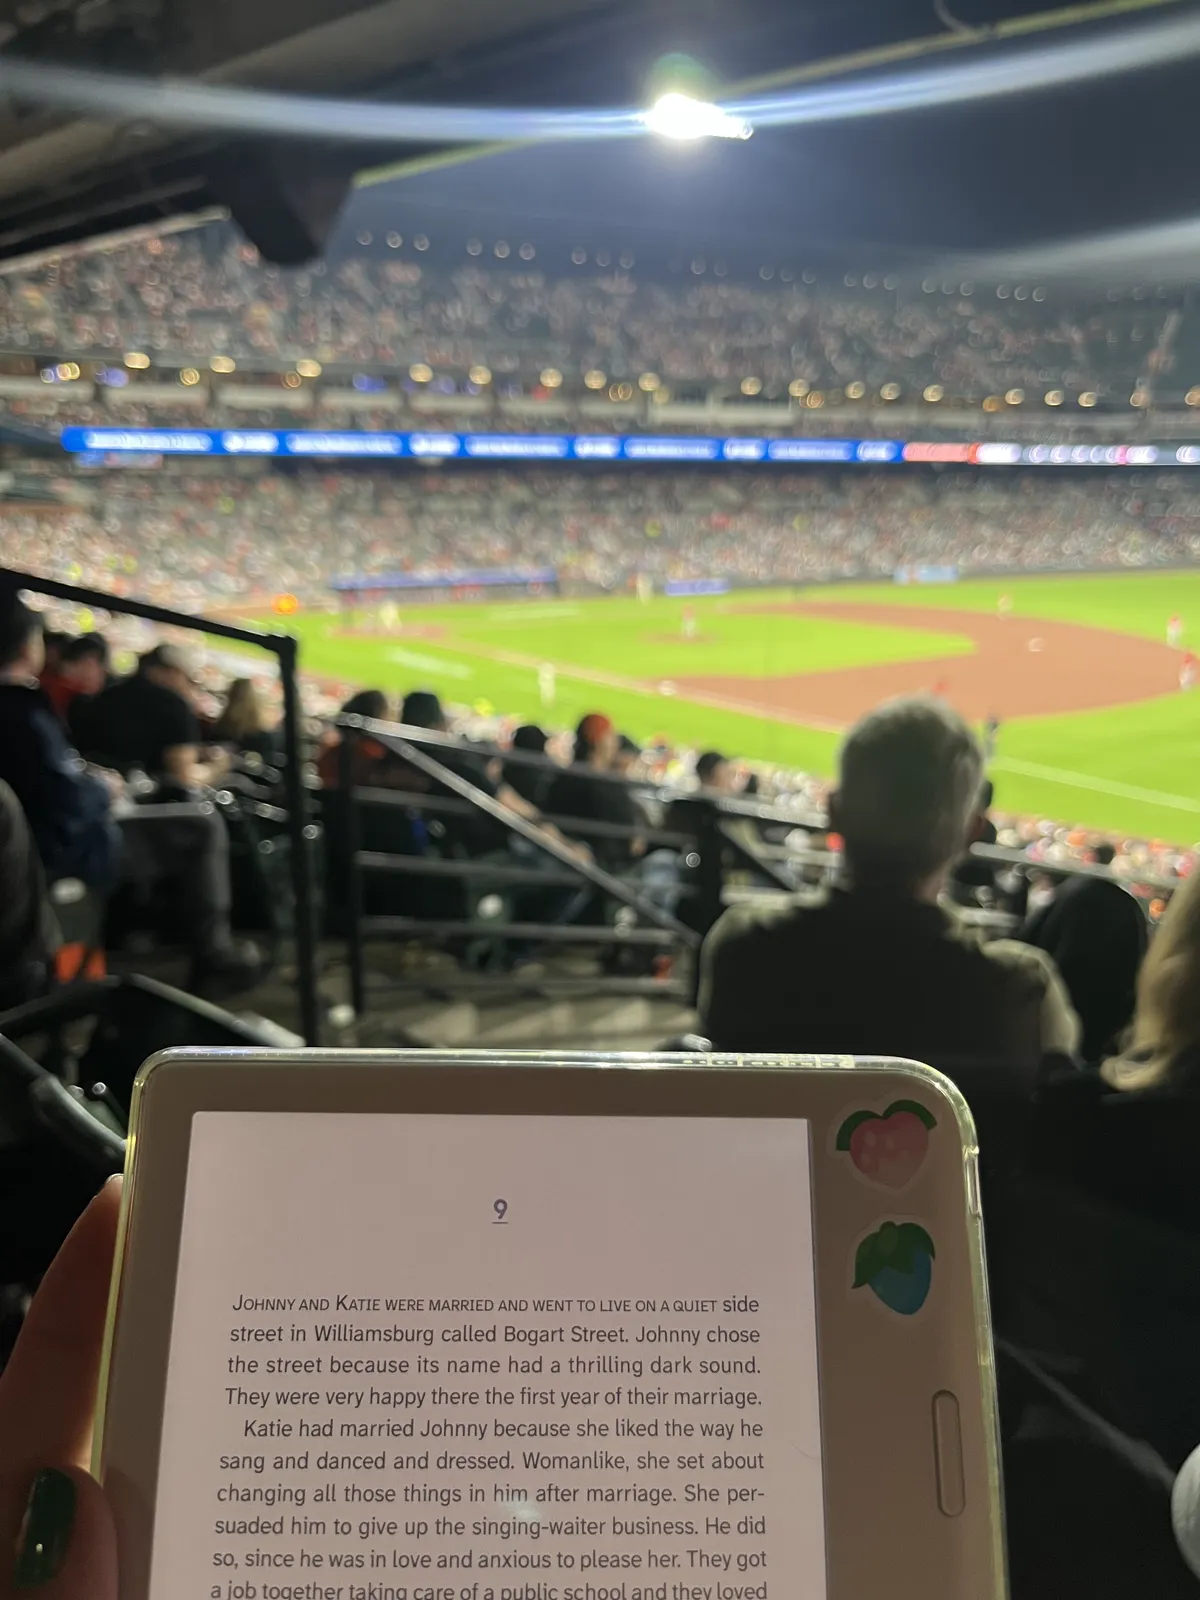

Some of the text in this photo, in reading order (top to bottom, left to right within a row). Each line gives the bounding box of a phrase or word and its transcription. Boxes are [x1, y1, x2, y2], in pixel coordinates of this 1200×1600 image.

[493, 1198, 508, 1220] 9
[232, 1293, 760, 1313] JOHNNY AND KATIE WERE MARRIED AND WENT TO LIVE ON A QUIET side
[229, 1323, 761, 1347] street in Williamsburg called Bogart Street. Johnny chose
[227, 1354, 761, 1378] the street because its name had a thrilling dark sound.
[224, 1386, 762, 1410] They were very happy there the first year of their marriage.
[244, 1417, 764, 1441] Katie had married Johnny because she liked the way he
[219, 1449, 765, 1474] sang and danced and dressed. Womanlike, she set about
[216, 1482, 765, 1507] changing all those things in him after marriage. She per-
[214, 1515, 766, 1540] suaded him to give up the singing-waiter business. He did
[212, 1547, 768, 1573] so, since he was in love and anxious to please her. They got
[210, 1585, 222, 1600] a
[412, 1587, 456, 1600] care
[459, 1582, 480, 1600] of
[483, 1587, 495, 1600] a
[563, 1582, 628, 1600] school
[631, 1581, 667, 1600] and
[716, 1581, 768, 1600] loved
